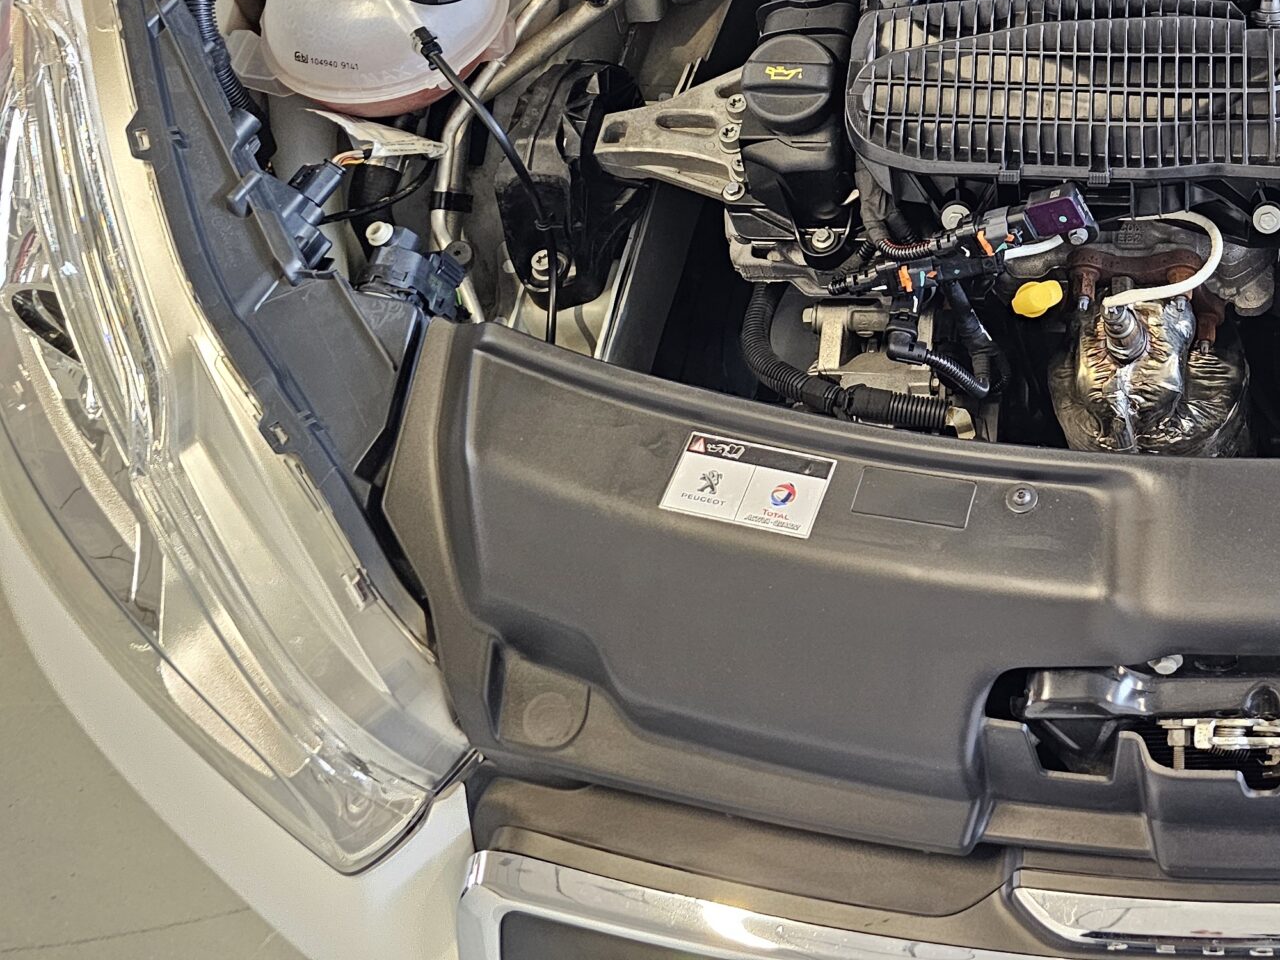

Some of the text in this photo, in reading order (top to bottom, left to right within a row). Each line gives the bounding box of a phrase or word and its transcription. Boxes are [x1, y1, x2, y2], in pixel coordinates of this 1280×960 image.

[310, 57, 338, 68] 104940
[340, 61, 359, 71] 9141
[680, 492, 726, 506] PEUGEOT
